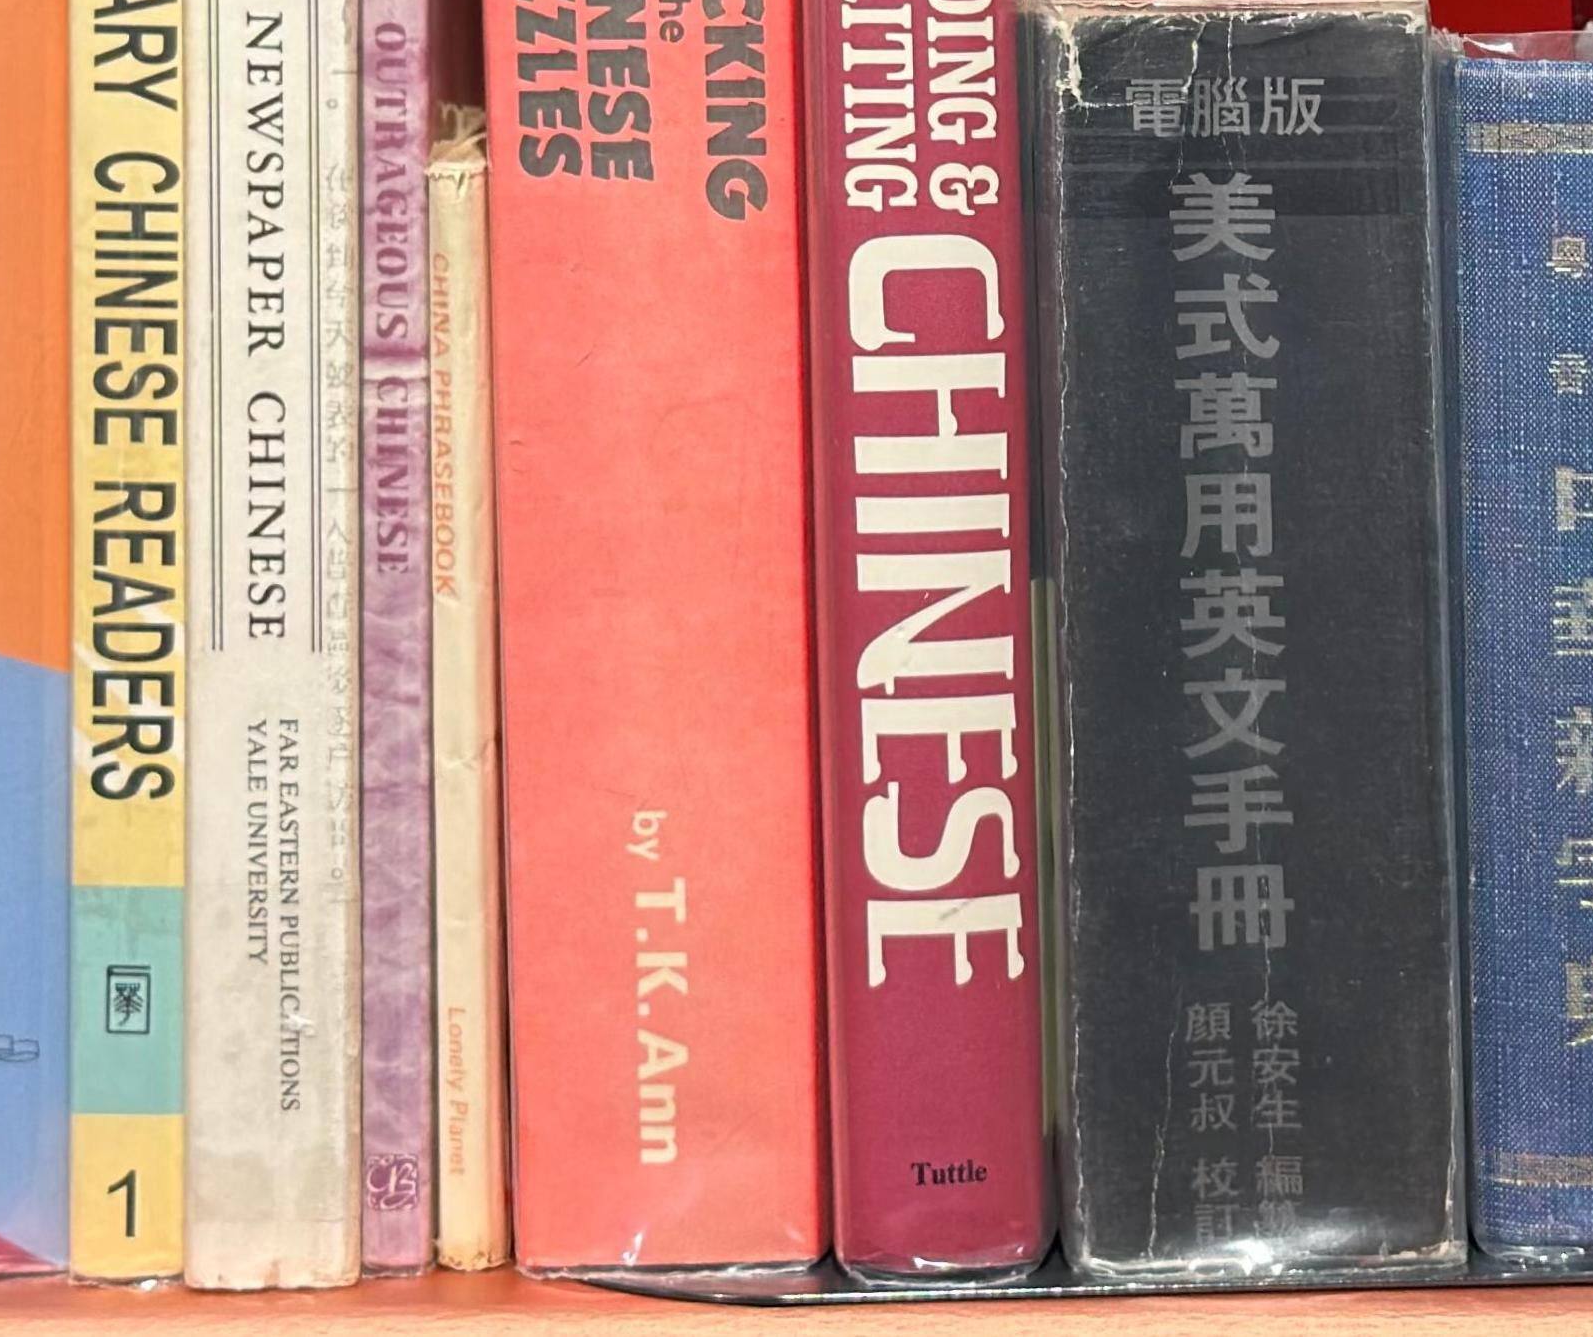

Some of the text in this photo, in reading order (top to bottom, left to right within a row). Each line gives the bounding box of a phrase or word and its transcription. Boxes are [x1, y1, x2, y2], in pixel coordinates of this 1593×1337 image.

[245, 11, 285, 358] NEWSPAPER
[929, 163, 1000, 217] &
[1125, 76, 1325, 138] 電腦版
[92, 151, 180, 447] CHINESE
[373, 21, 409, 577] OUTRAGEOUS CHINESE
[246, 392, 287, 641] CHINESE
[433, 252, 456, 596] CHINA PHRASEBOOK
[89, 481, 178, 802] READERS
[848, 232, 1025, 989] CHINESE
[1169, 172, 1295, 951] 美式萬用英文手冊
[247, 718, 269, 965] YALE UNIVERSITY
[278, 718, 299, 773] FAR
[279, 780, 300, 906] EASTERN
[626, 809, 668, 862] by
[447, 1007, 469, 1175] Lonely Planet
[1250, 999, 1302, 1129] 徐安生
[107, 1169, 137, 1239] 1
[911, 1159, 988, 1187] Tuttle
